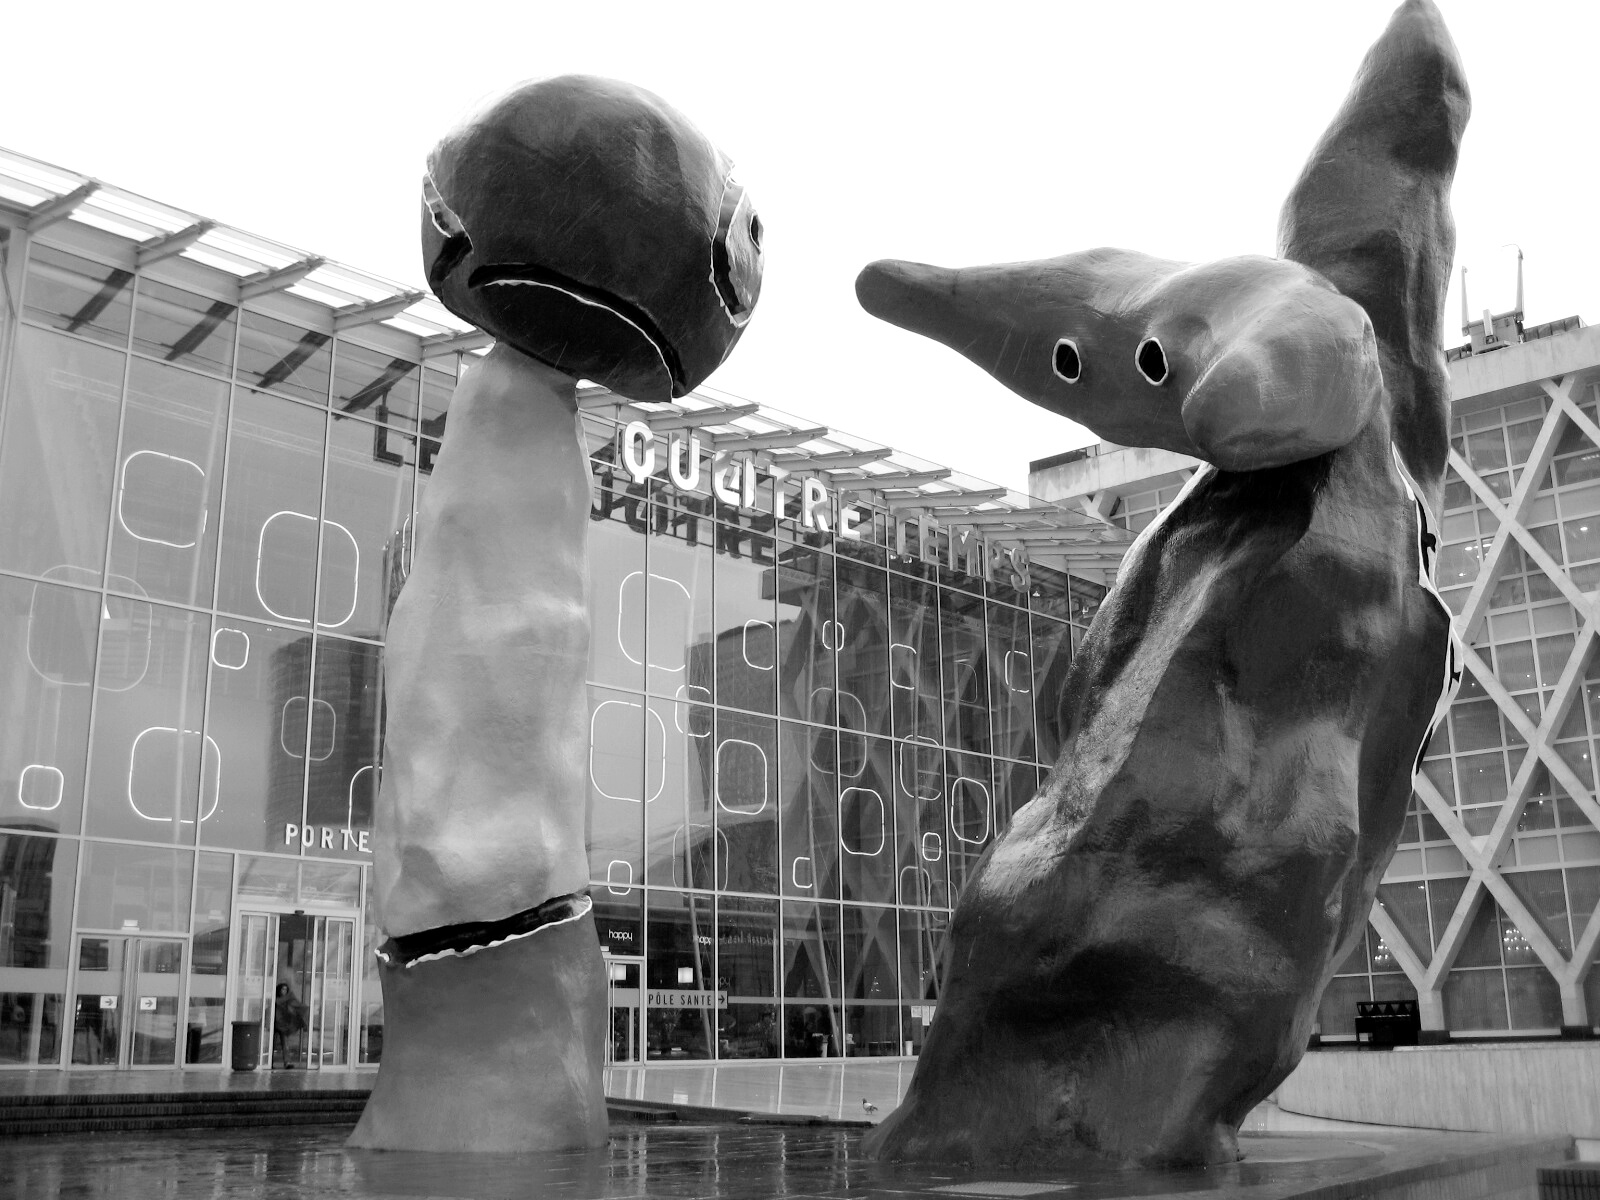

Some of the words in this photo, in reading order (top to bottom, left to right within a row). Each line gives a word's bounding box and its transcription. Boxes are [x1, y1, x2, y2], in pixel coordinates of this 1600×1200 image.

[621, 420, 861, 542] QUATRE
[889, 506, 1032, 594] TEMPS
[284, 823, 371, 853] PORTE
[608, 928, 633, 941] happy
[648, 991, 675, 1006] PÔLE
